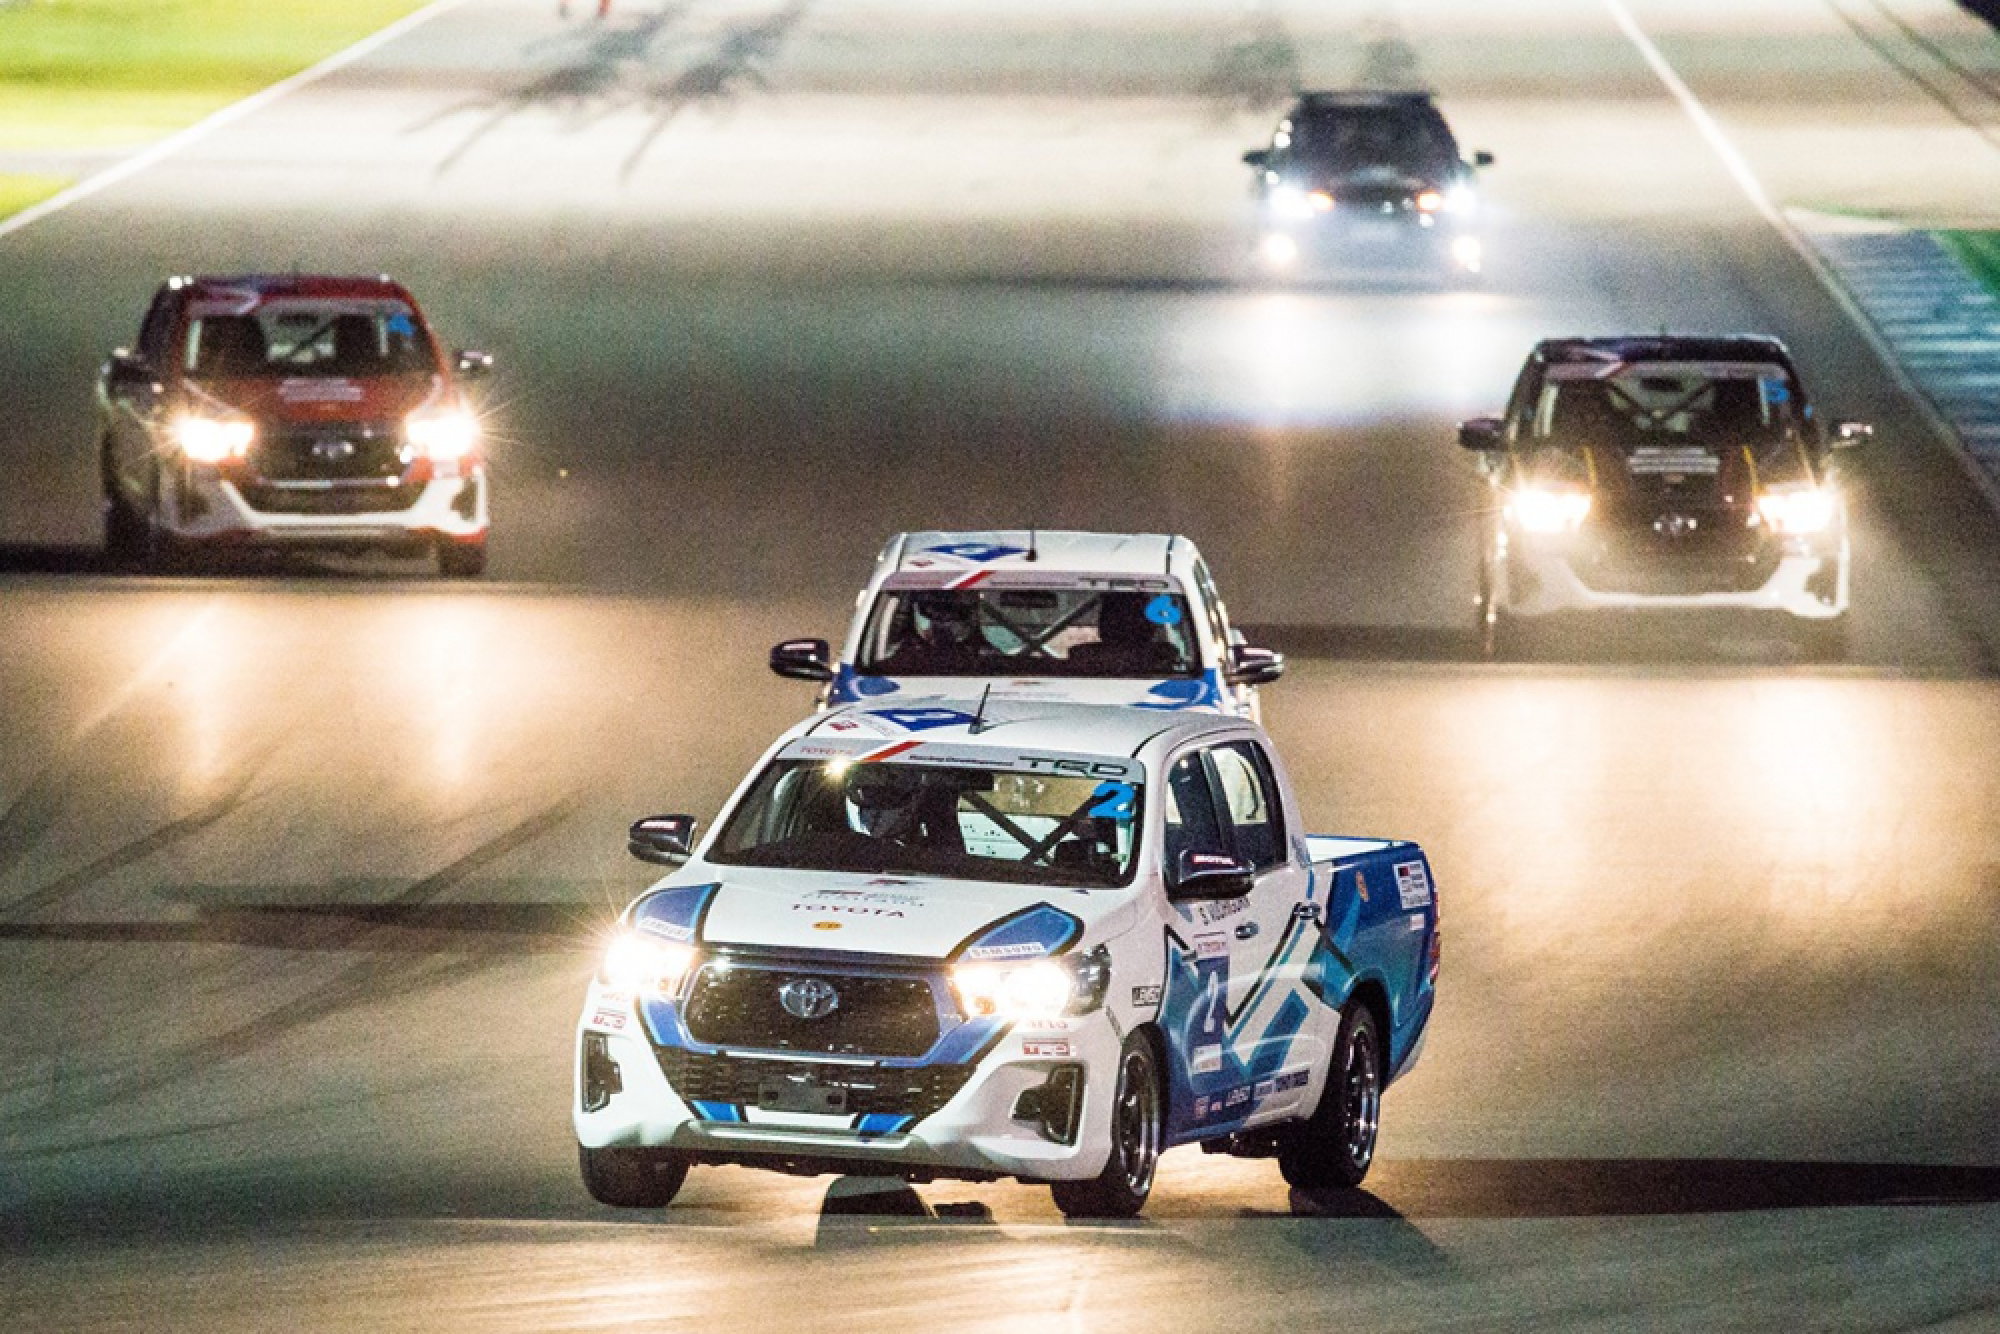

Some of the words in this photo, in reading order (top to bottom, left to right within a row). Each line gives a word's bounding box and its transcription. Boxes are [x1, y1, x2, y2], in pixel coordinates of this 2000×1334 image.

[1144, 595, 1182, 625] 6
[1018, 755, 1129, 778] TRD
[1089, 781, 1136, 819] 2
[792, 903, 904, 918] TOYOTA
